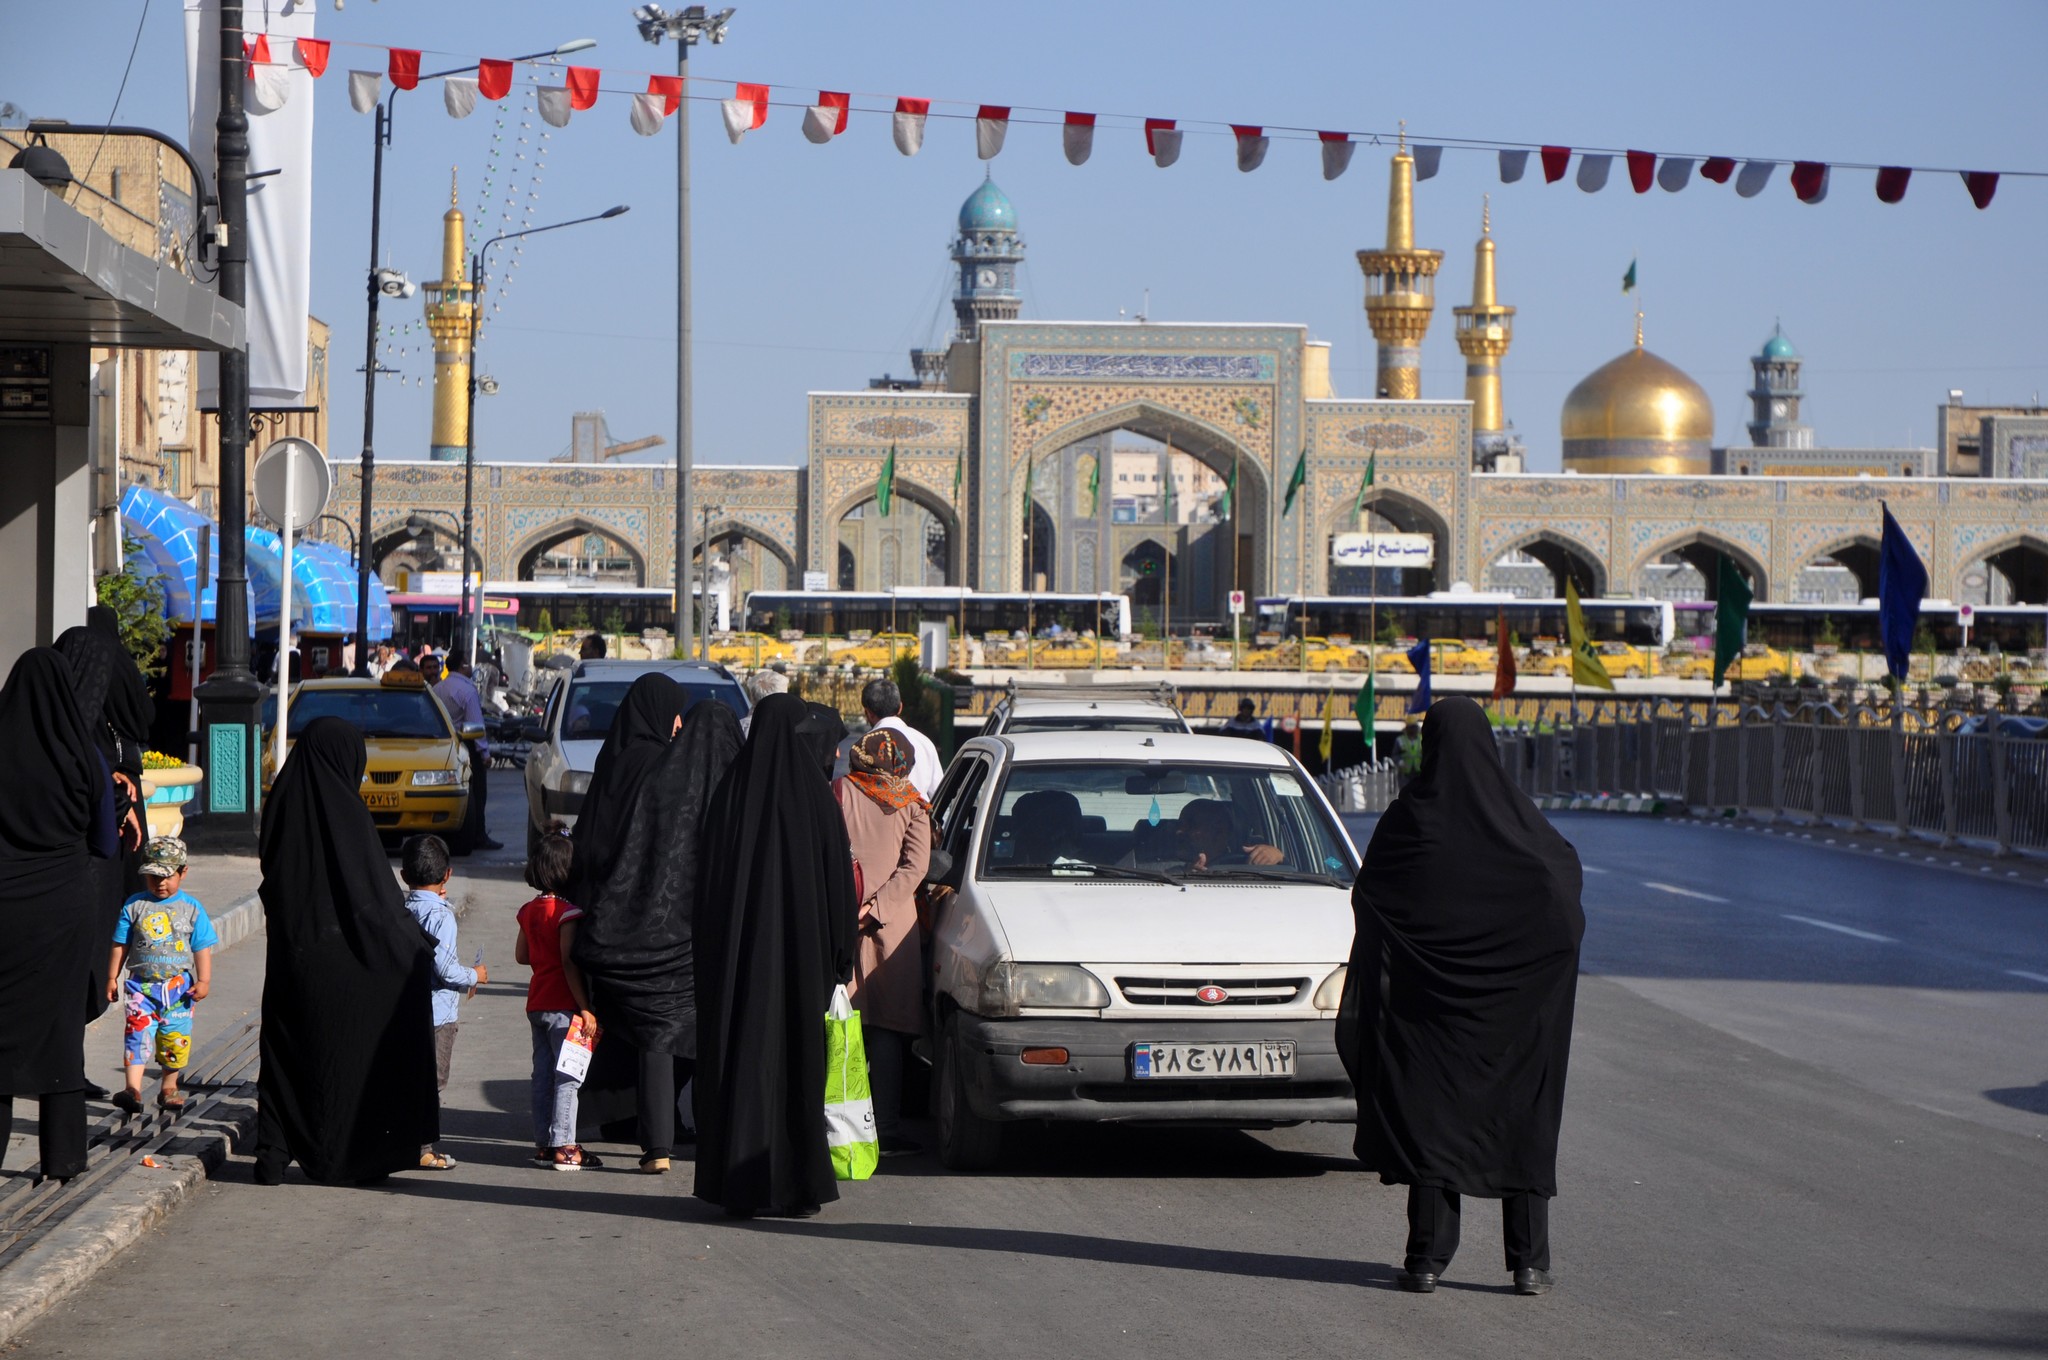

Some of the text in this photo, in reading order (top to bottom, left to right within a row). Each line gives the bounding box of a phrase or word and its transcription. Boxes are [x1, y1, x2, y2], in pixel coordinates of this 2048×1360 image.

[1337, 539, 1375, 558] طوسی
[1377, 541, 1401, 558] شیخ
[1265, 1051, 1292, 1073] ۱۲
